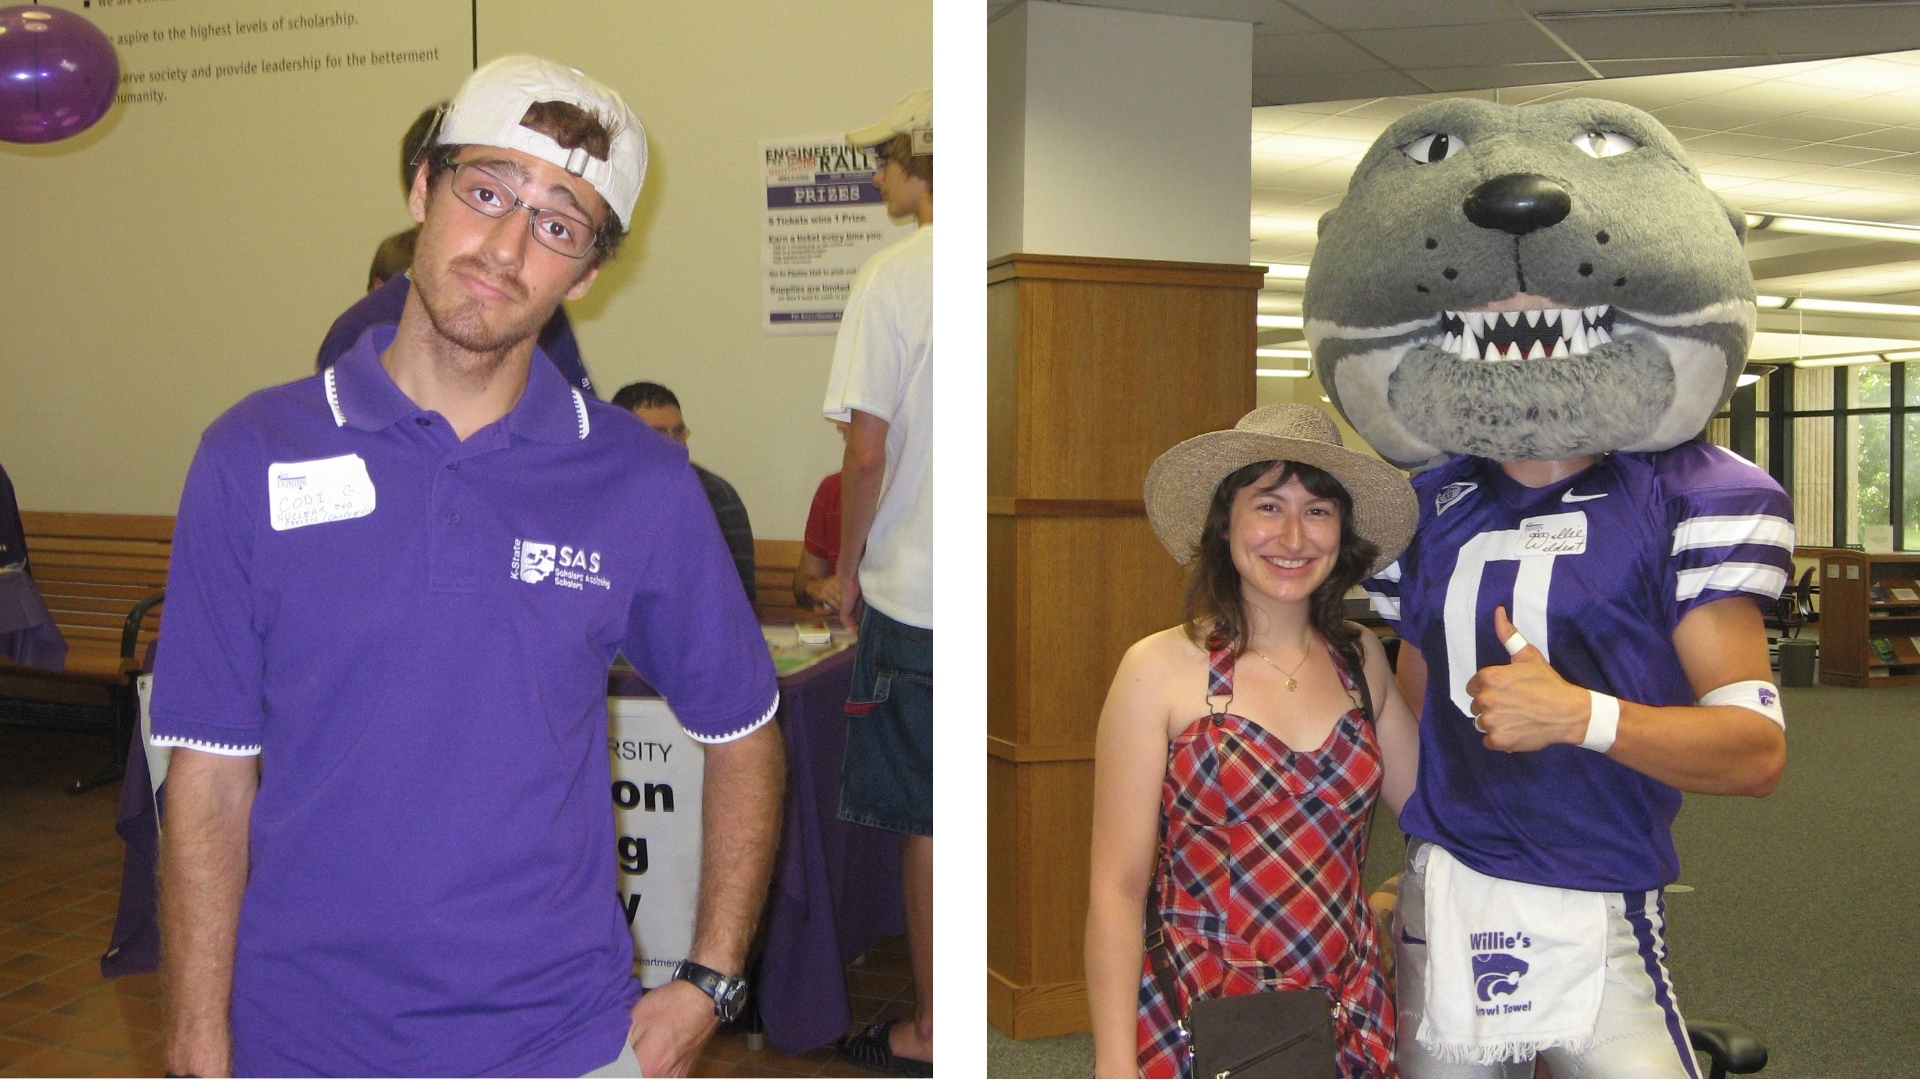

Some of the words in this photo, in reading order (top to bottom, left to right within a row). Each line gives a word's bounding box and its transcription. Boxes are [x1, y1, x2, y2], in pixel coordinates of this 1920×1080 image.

[117, 31, 149, 47] aspire
[153, 29, 164, 42] to
[168, 27, 186, 40] the
[190, 22, 232, 40] highest
[236, 19, 268, 35] levels
[272, 16, 285, 31] of
[288, 10, 358, 30] scholarship.
[149, 68, 187, 83] society
[191, 64, 211, 79] and
[215, 60, 257, 80] provide
[261, 55, 321, 73] leadership
[325, 53, 342, 69] for
[346, 50, 367, 67] the
[371, 47, 439, 66] betterment
[820, 147, 874, 172] RALL
[794, 184, 860, 203] PRIZES
[776, 215, 808, 226] Tickets
[811, 214, 832, 225] wins
[769, 234, 788, 244] Earn
[797, 233, 820, 243] ticket
[822, 234, 844, 244] every
[846, 231, 864, 241] time
[770, 284, 804, 295] Supplies
[807, 284, 820, 294] are
[510, 538, 521, 580] K-State
[558, 546, 600, 573] SAS
[554, 568, 584, 582] Scholars
[585, 575, 611, 590] Assisting
[554, 577, 583, 591] Scholars
[1469, 931, 1531, 950] Willie's
[1503, 1000, 1532, 1014] Towel
